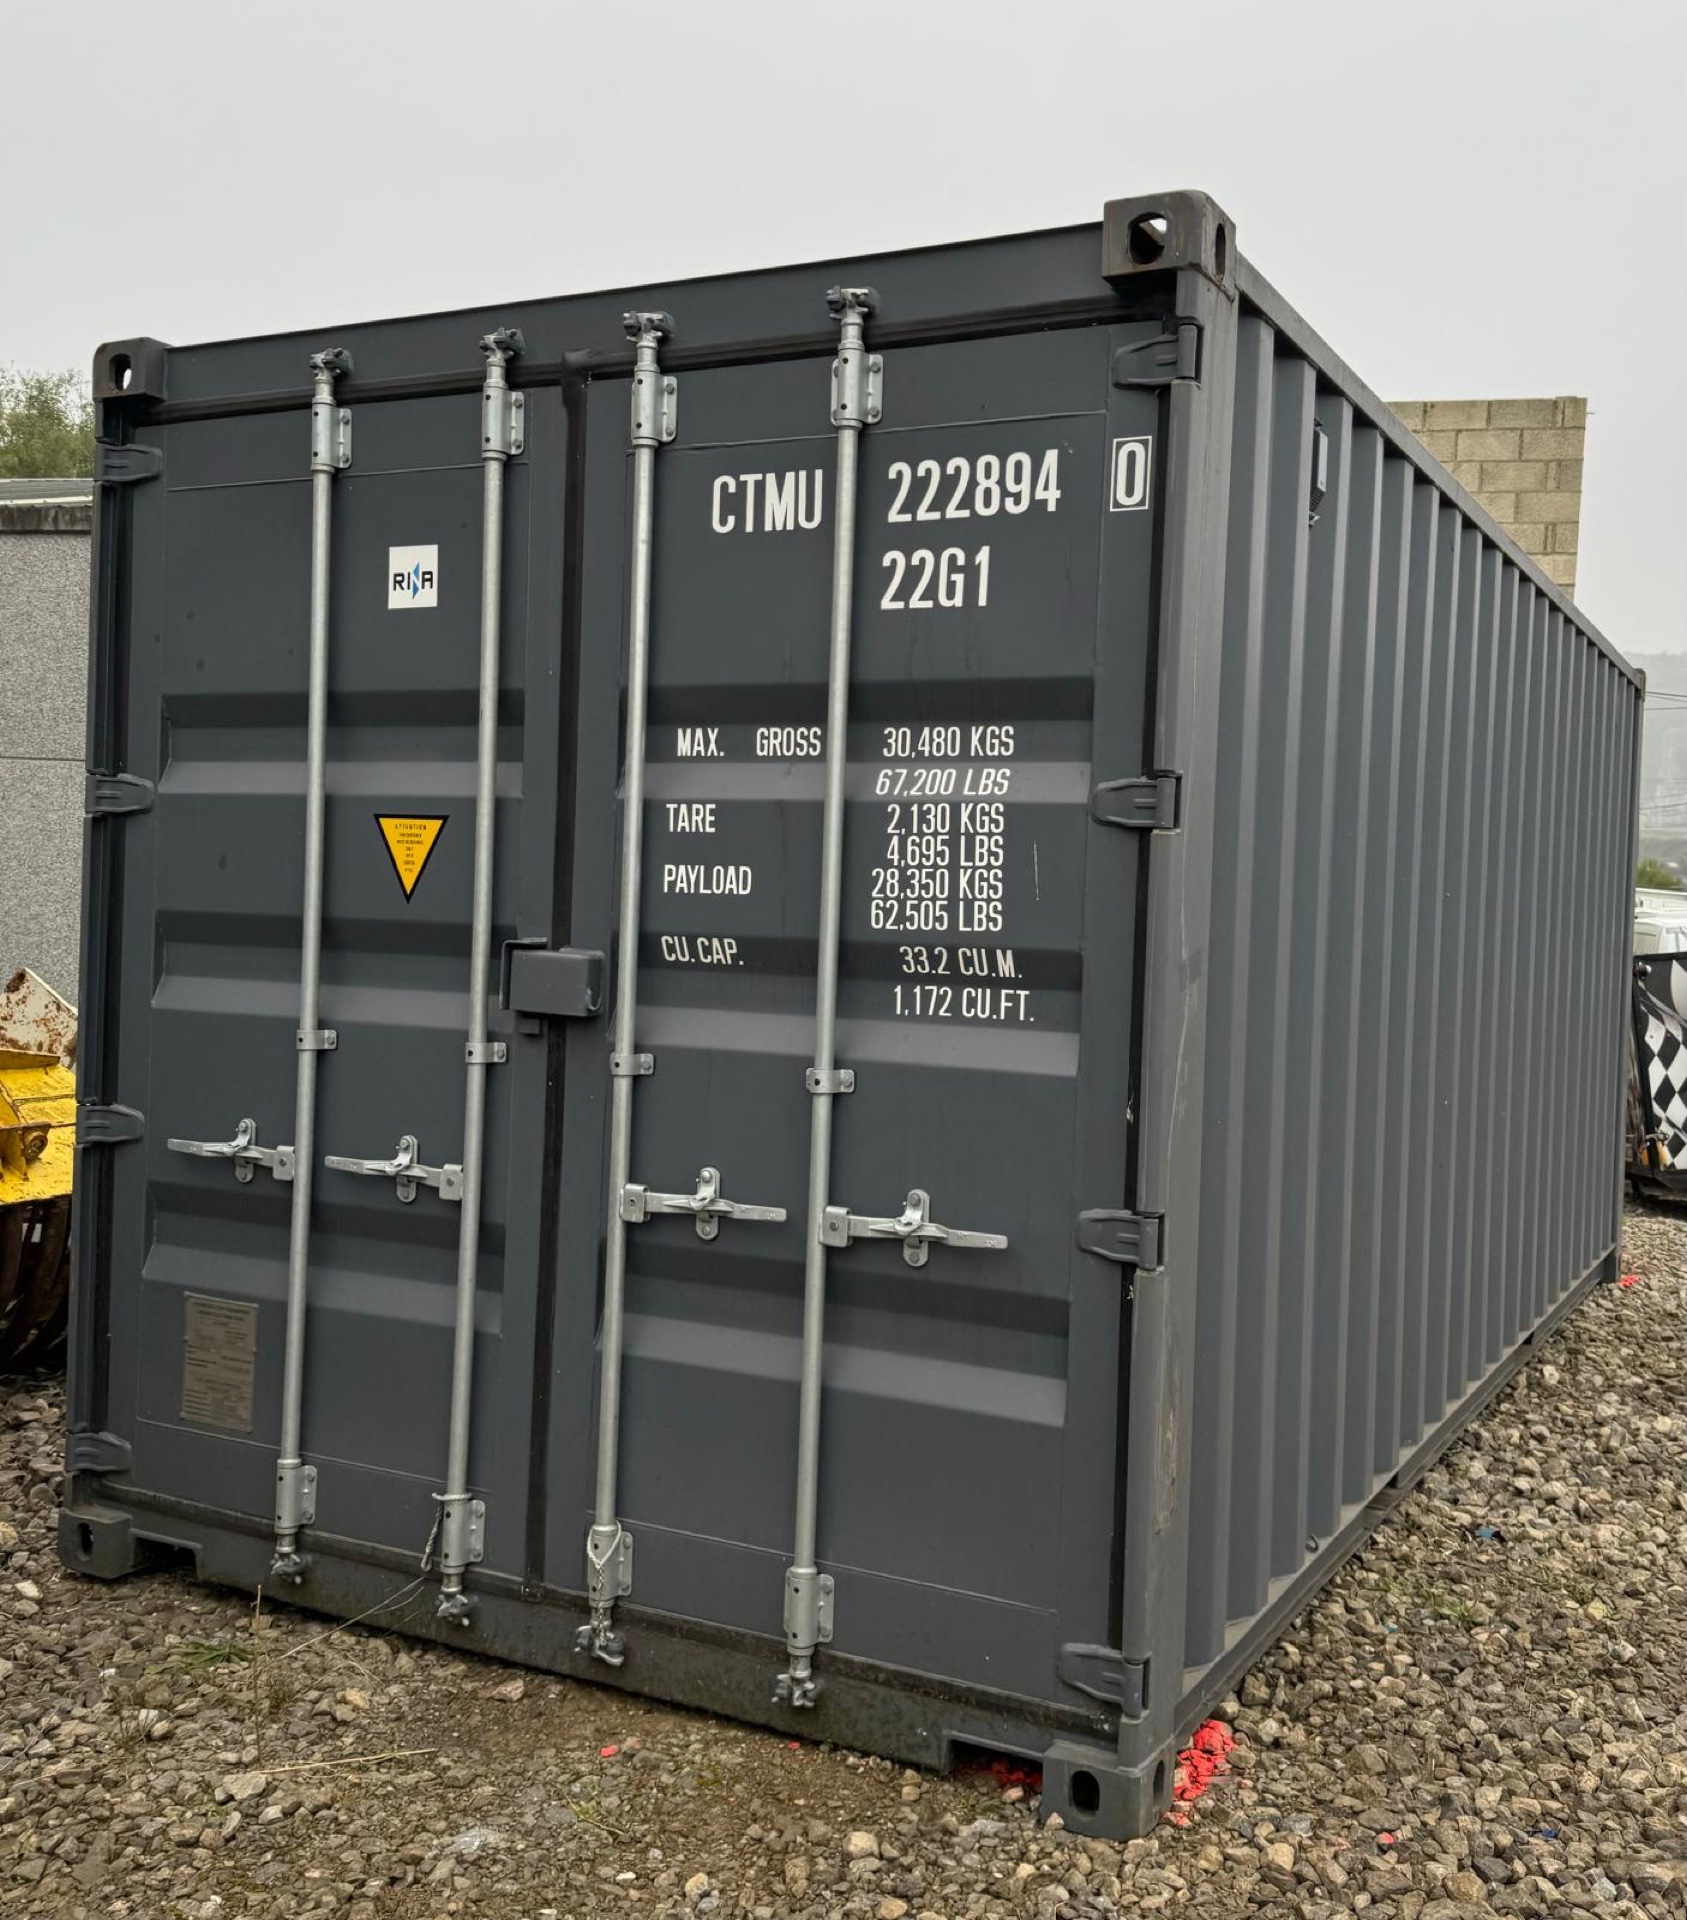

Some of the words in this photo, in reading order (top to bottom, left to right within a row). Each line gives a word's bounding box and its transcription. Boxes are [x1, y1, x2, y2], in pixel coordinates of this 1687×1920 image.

[711, 468, 823, 534] CTMU
[887, 448, 1062, 523] 222894
[1114, 440, 1147, 507] 0
[880, 545, 990, 611] 22G1
[677, 727, 725, 757] MAX.
[756, 726, 822, 757] GROSS
[882, 726, 961, 759] 30,480
[970, 725, 1015, 757] KGS
[962, 768, 1011, 796] LBS
[665, 803, 716, 833] TARE
[887, 802, 951, 836] 2,130
[960, 802, 1005, 834] KGS
[886, 835, 950, 868] 4,695
[959, 834, 1004, 867] LBS
[663, 864, 752, 895] PAYLOAD
[871, 867, 949, 902] 28,350
[959, 868, 1003, 900] KGS
[870, 899, 949, 931] 62,505
[958, 900, 1003, 932] LBS
[899, 945, 951, 975] 33.2
[957, 947, 1023, 979] CU.M.
[894, 984, 953, 1017] 1,172
[961, 987, 1035, 1022] CU.FT.
